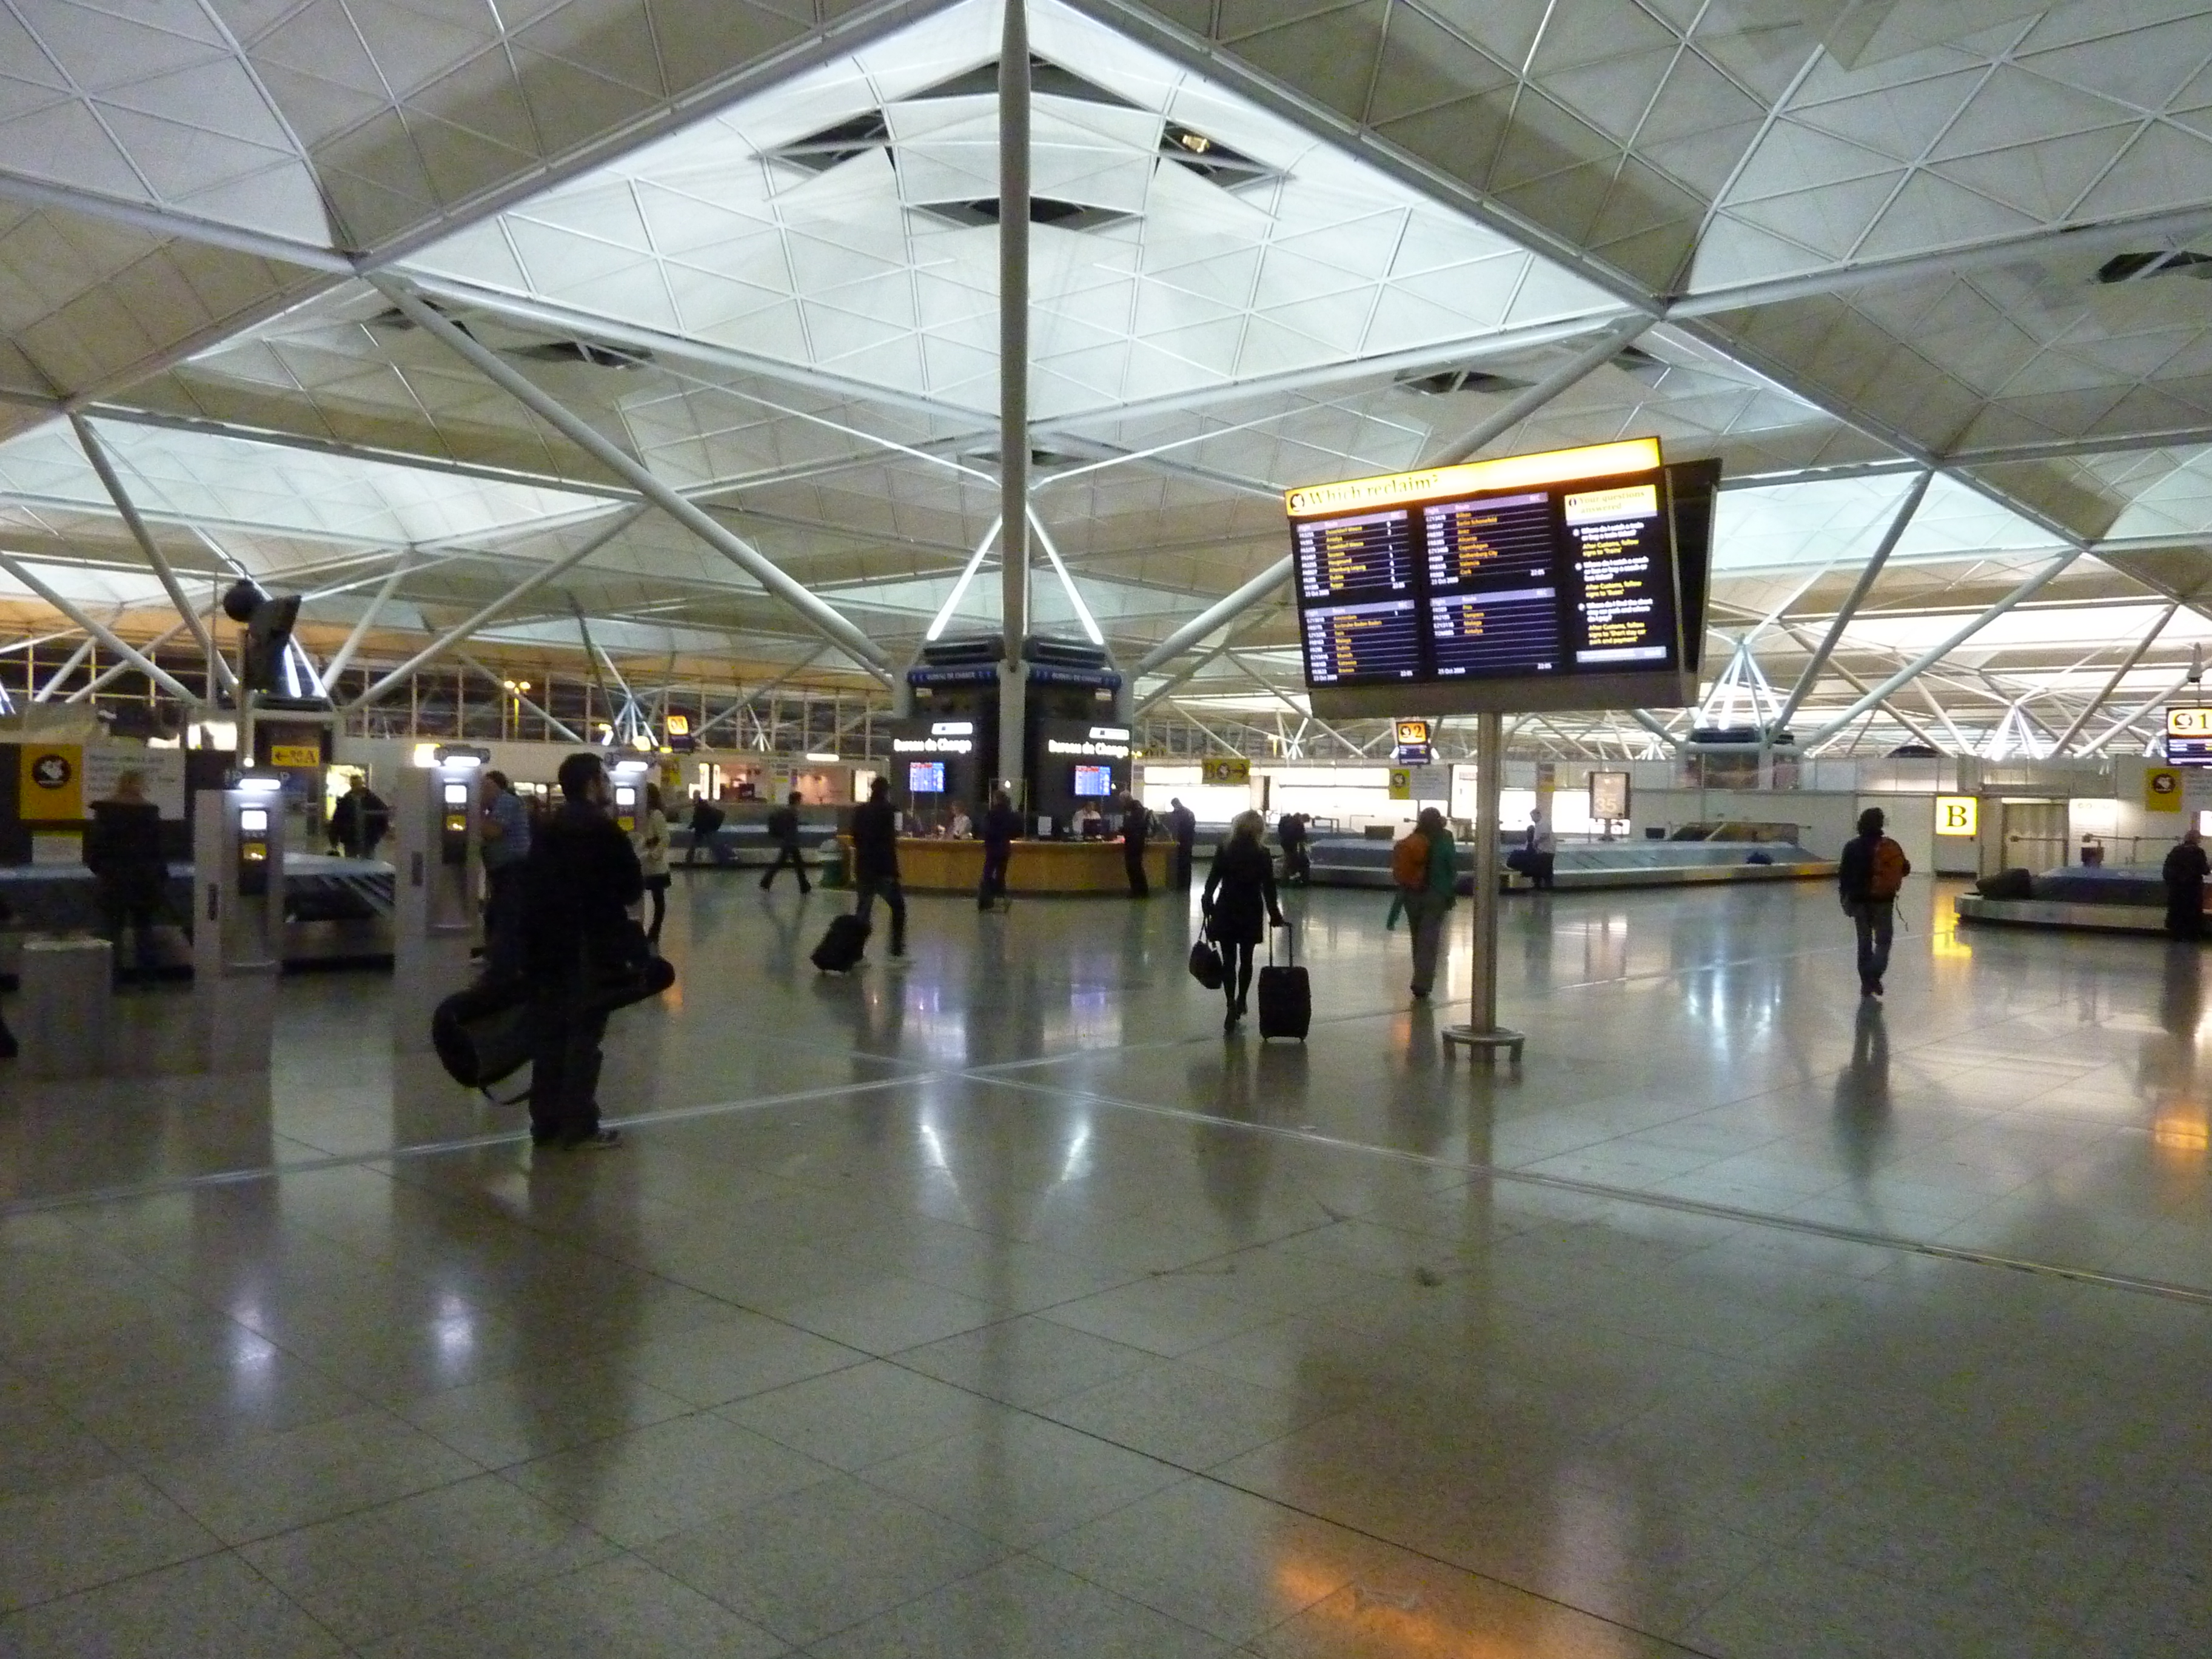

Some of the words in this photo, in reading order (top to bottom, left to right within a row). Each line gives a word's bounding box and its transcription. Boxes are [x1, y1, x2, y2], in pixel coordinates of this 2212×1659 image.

[1309, 486, 1361, 504] Which
[1367, 474, 1439, 496] reclaim?
[1603, 491, 1644, 500] questions
[1581, 503, 1621, 514] answered
[2199, 713, 2209, 729] 1
[1413, 725, 1423, 738] 2
[894, 738, 924, 752] Bureau
[925, 737, 937, 751] de
[937, 737, 972, 754] Change
[1048, 740, 1081, 754] Bureau
[1082, 742, 1094, 755] de
[1095, 742, 1130, 759] Change
[1946, 805, 1967, 827] B
